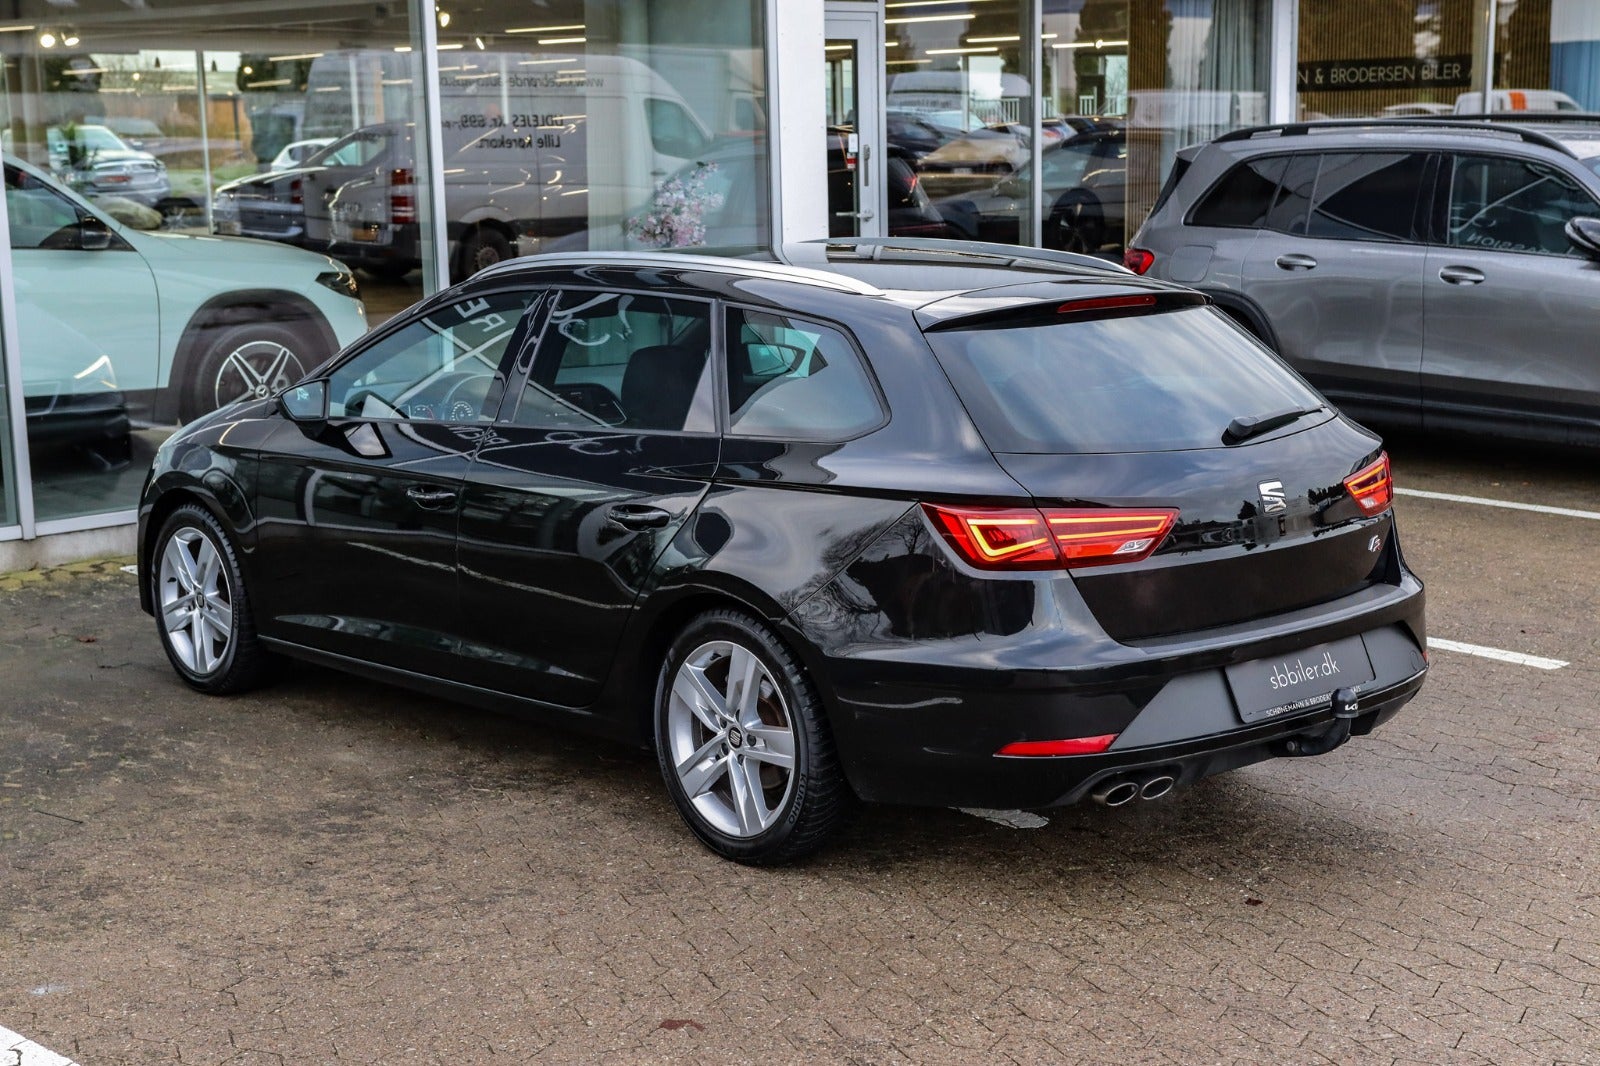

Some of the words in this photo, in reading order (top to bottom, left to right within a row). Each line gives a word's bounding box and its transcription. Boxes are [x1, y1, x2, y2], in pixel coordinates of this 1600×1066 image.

[1315, 68, 1324, 84] &
[1330, 65, 1415, 84] BRODERSEN
[1421, 63, 1461, 81] BILER
[1270, 652, 1340, 689] sbbiler.dk
[787, 773, 808, 824] KUMHO
